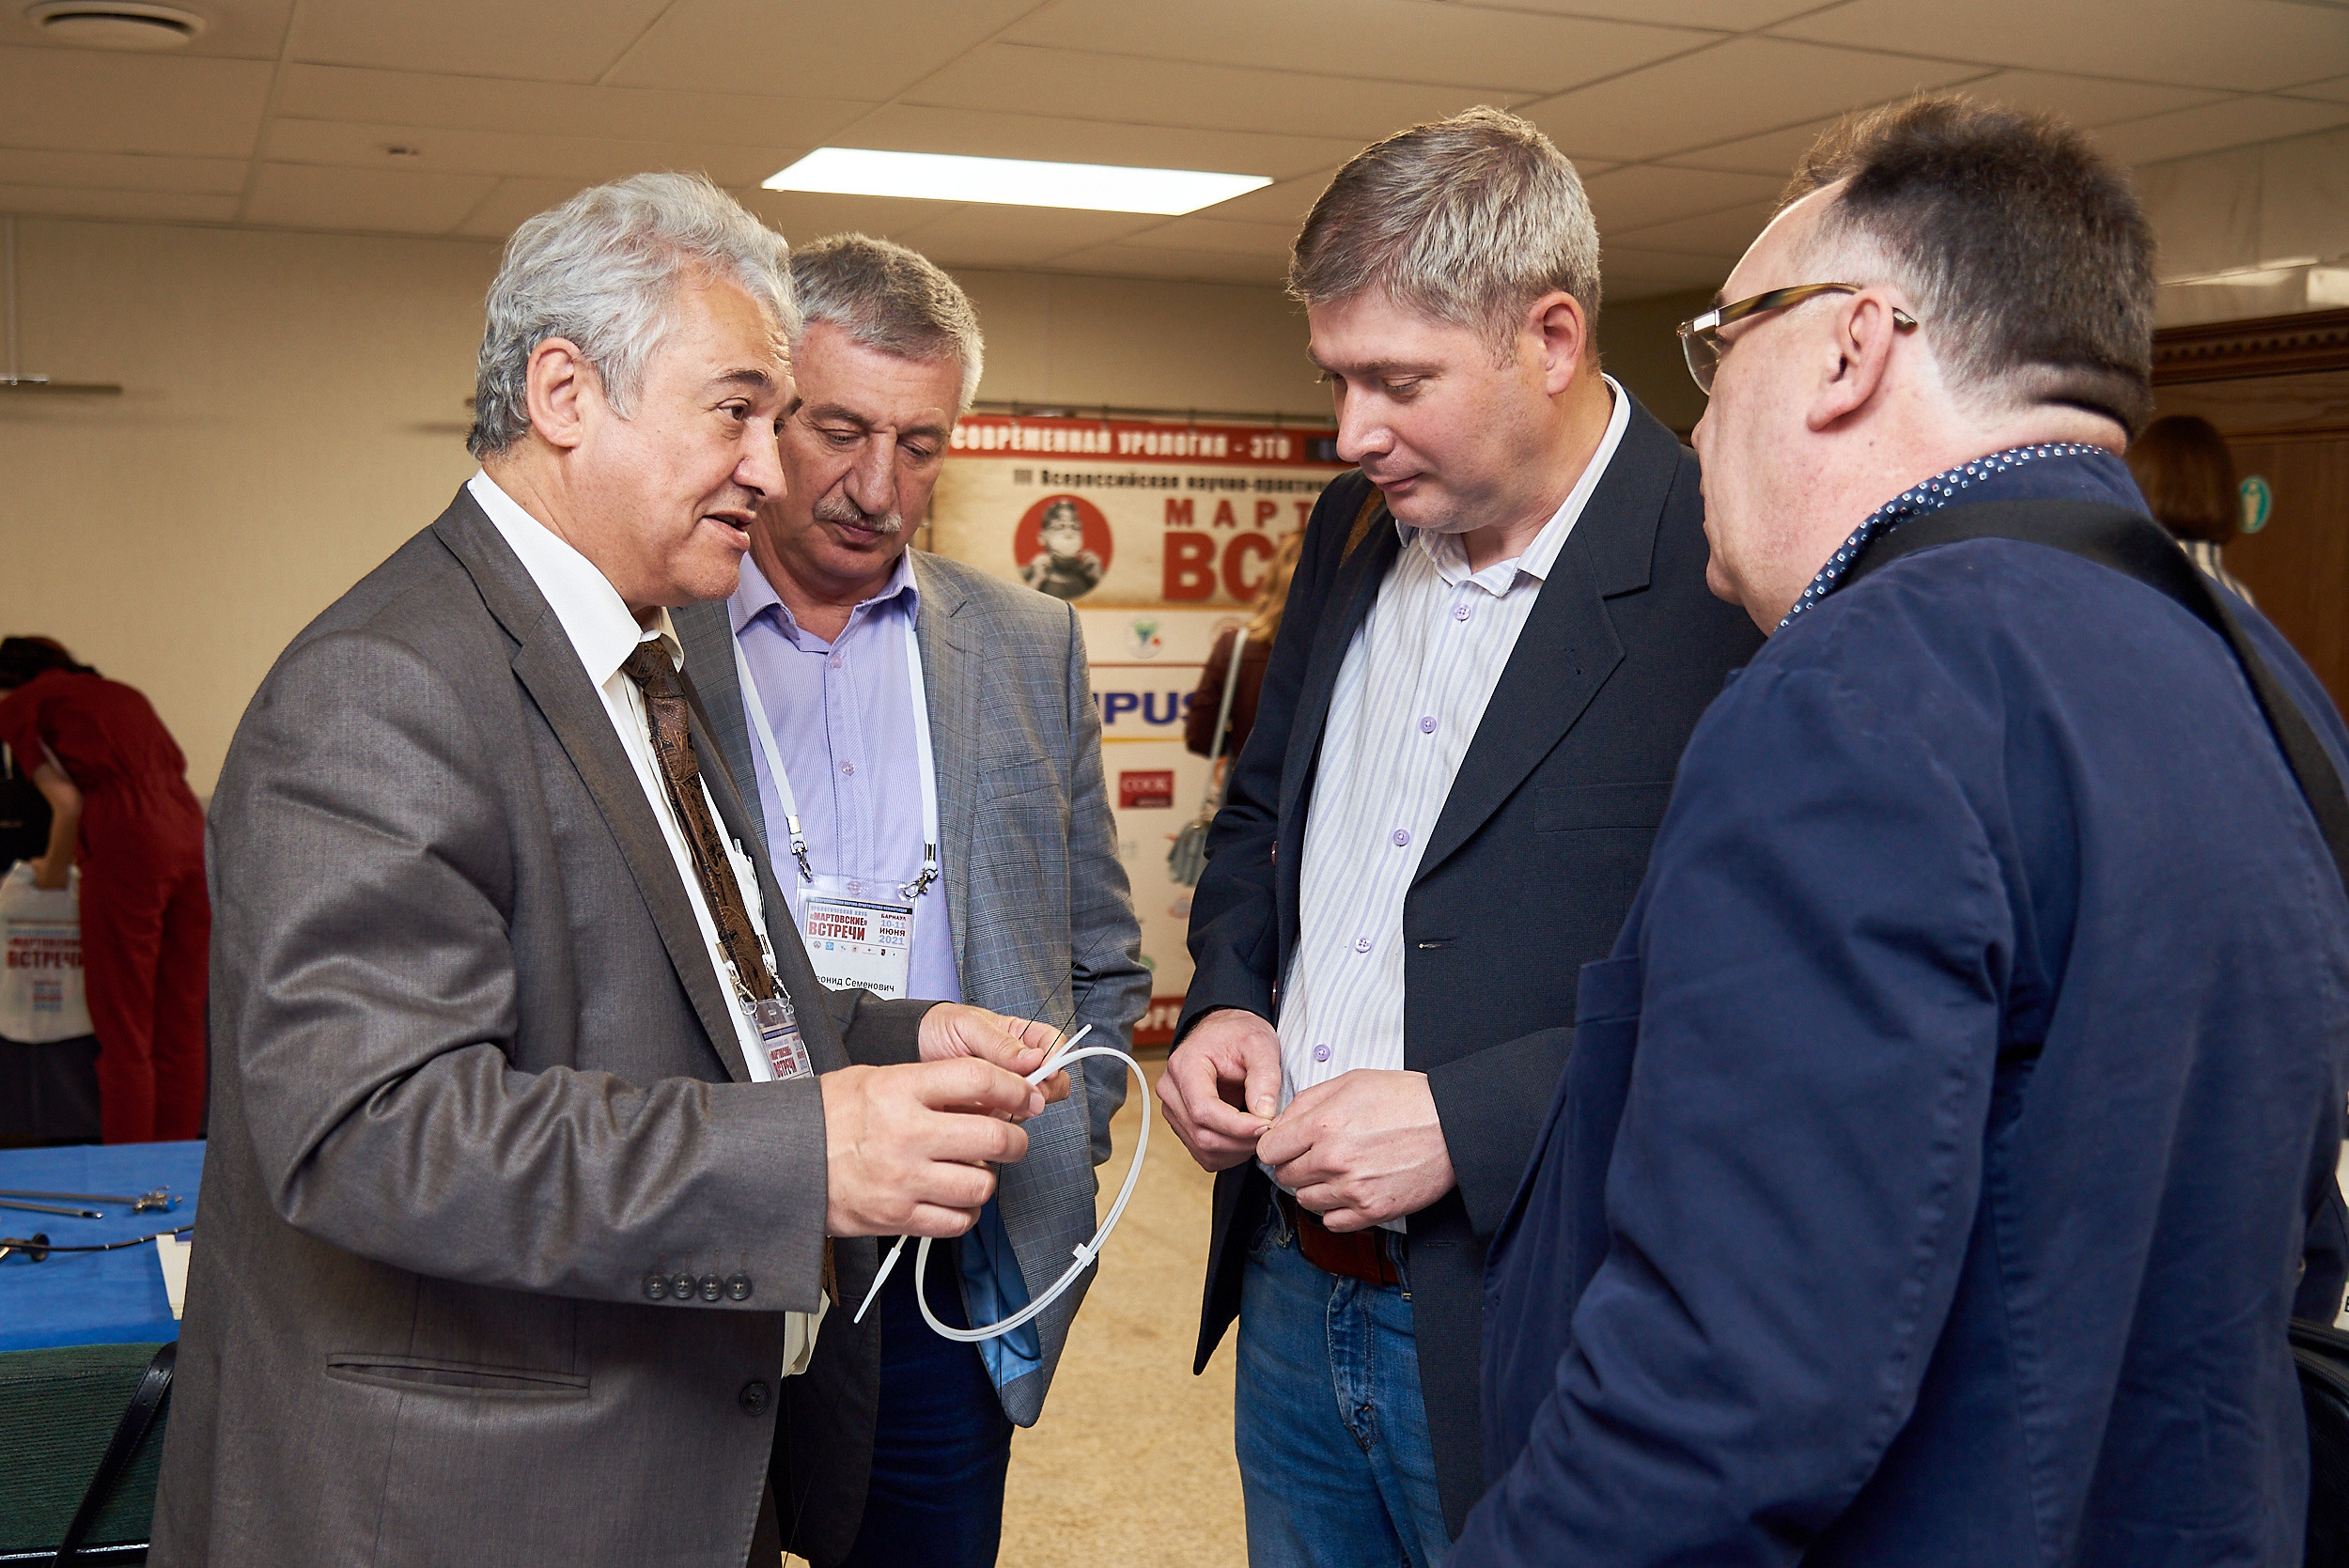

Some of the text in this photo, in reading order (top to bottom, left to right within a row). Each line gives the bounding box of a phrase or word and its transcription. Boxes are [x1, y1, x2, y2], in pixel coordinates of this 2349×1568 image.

[1250, 435, 1291, 460] ЭТО
[880, 913, 907, 922] БАРНАУЛ
[881, 920, 906, 929] 10-11
[808, 922, 864, 940] ВСТРЕЧИ
[879, 927, 906, 938] ИЮНЯ
[879, 935, 905, 946] 2021
[845, 977, 895, 992] Семенович
